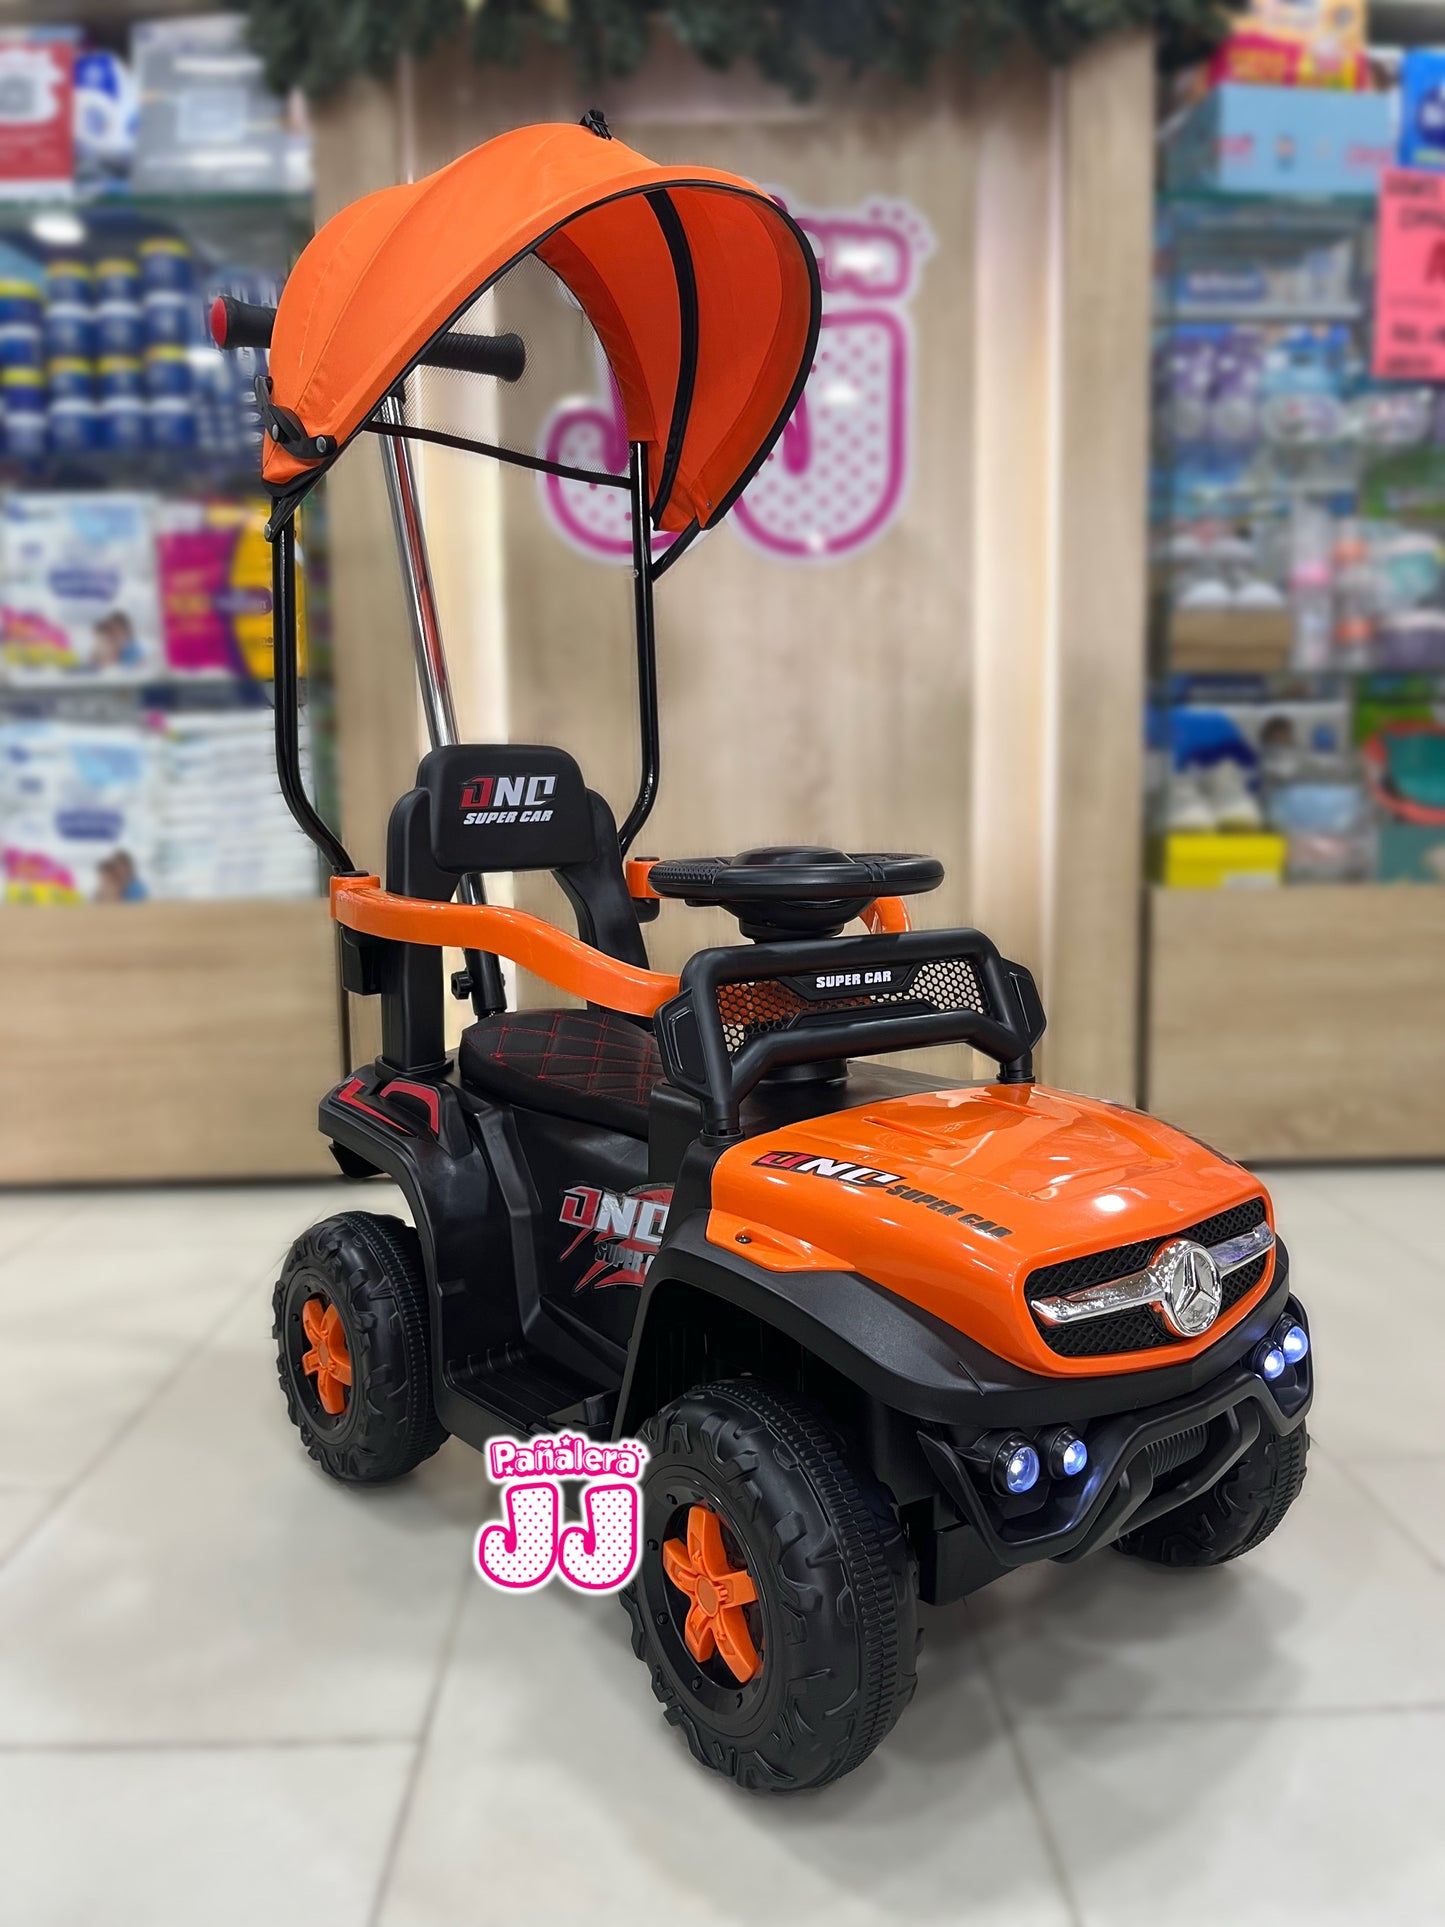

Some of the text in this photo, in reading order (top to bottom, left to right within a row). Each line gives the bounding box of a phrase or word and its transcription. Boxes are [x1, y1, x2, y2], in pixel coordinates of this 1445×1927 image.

[463, 810, 554, 825] SUPER CAR
[816, 970, 892, 989] SUPER CAR
[886, 1184, 964, 1217] SUPER
[957, 1213, 1014, 1239] CAR
